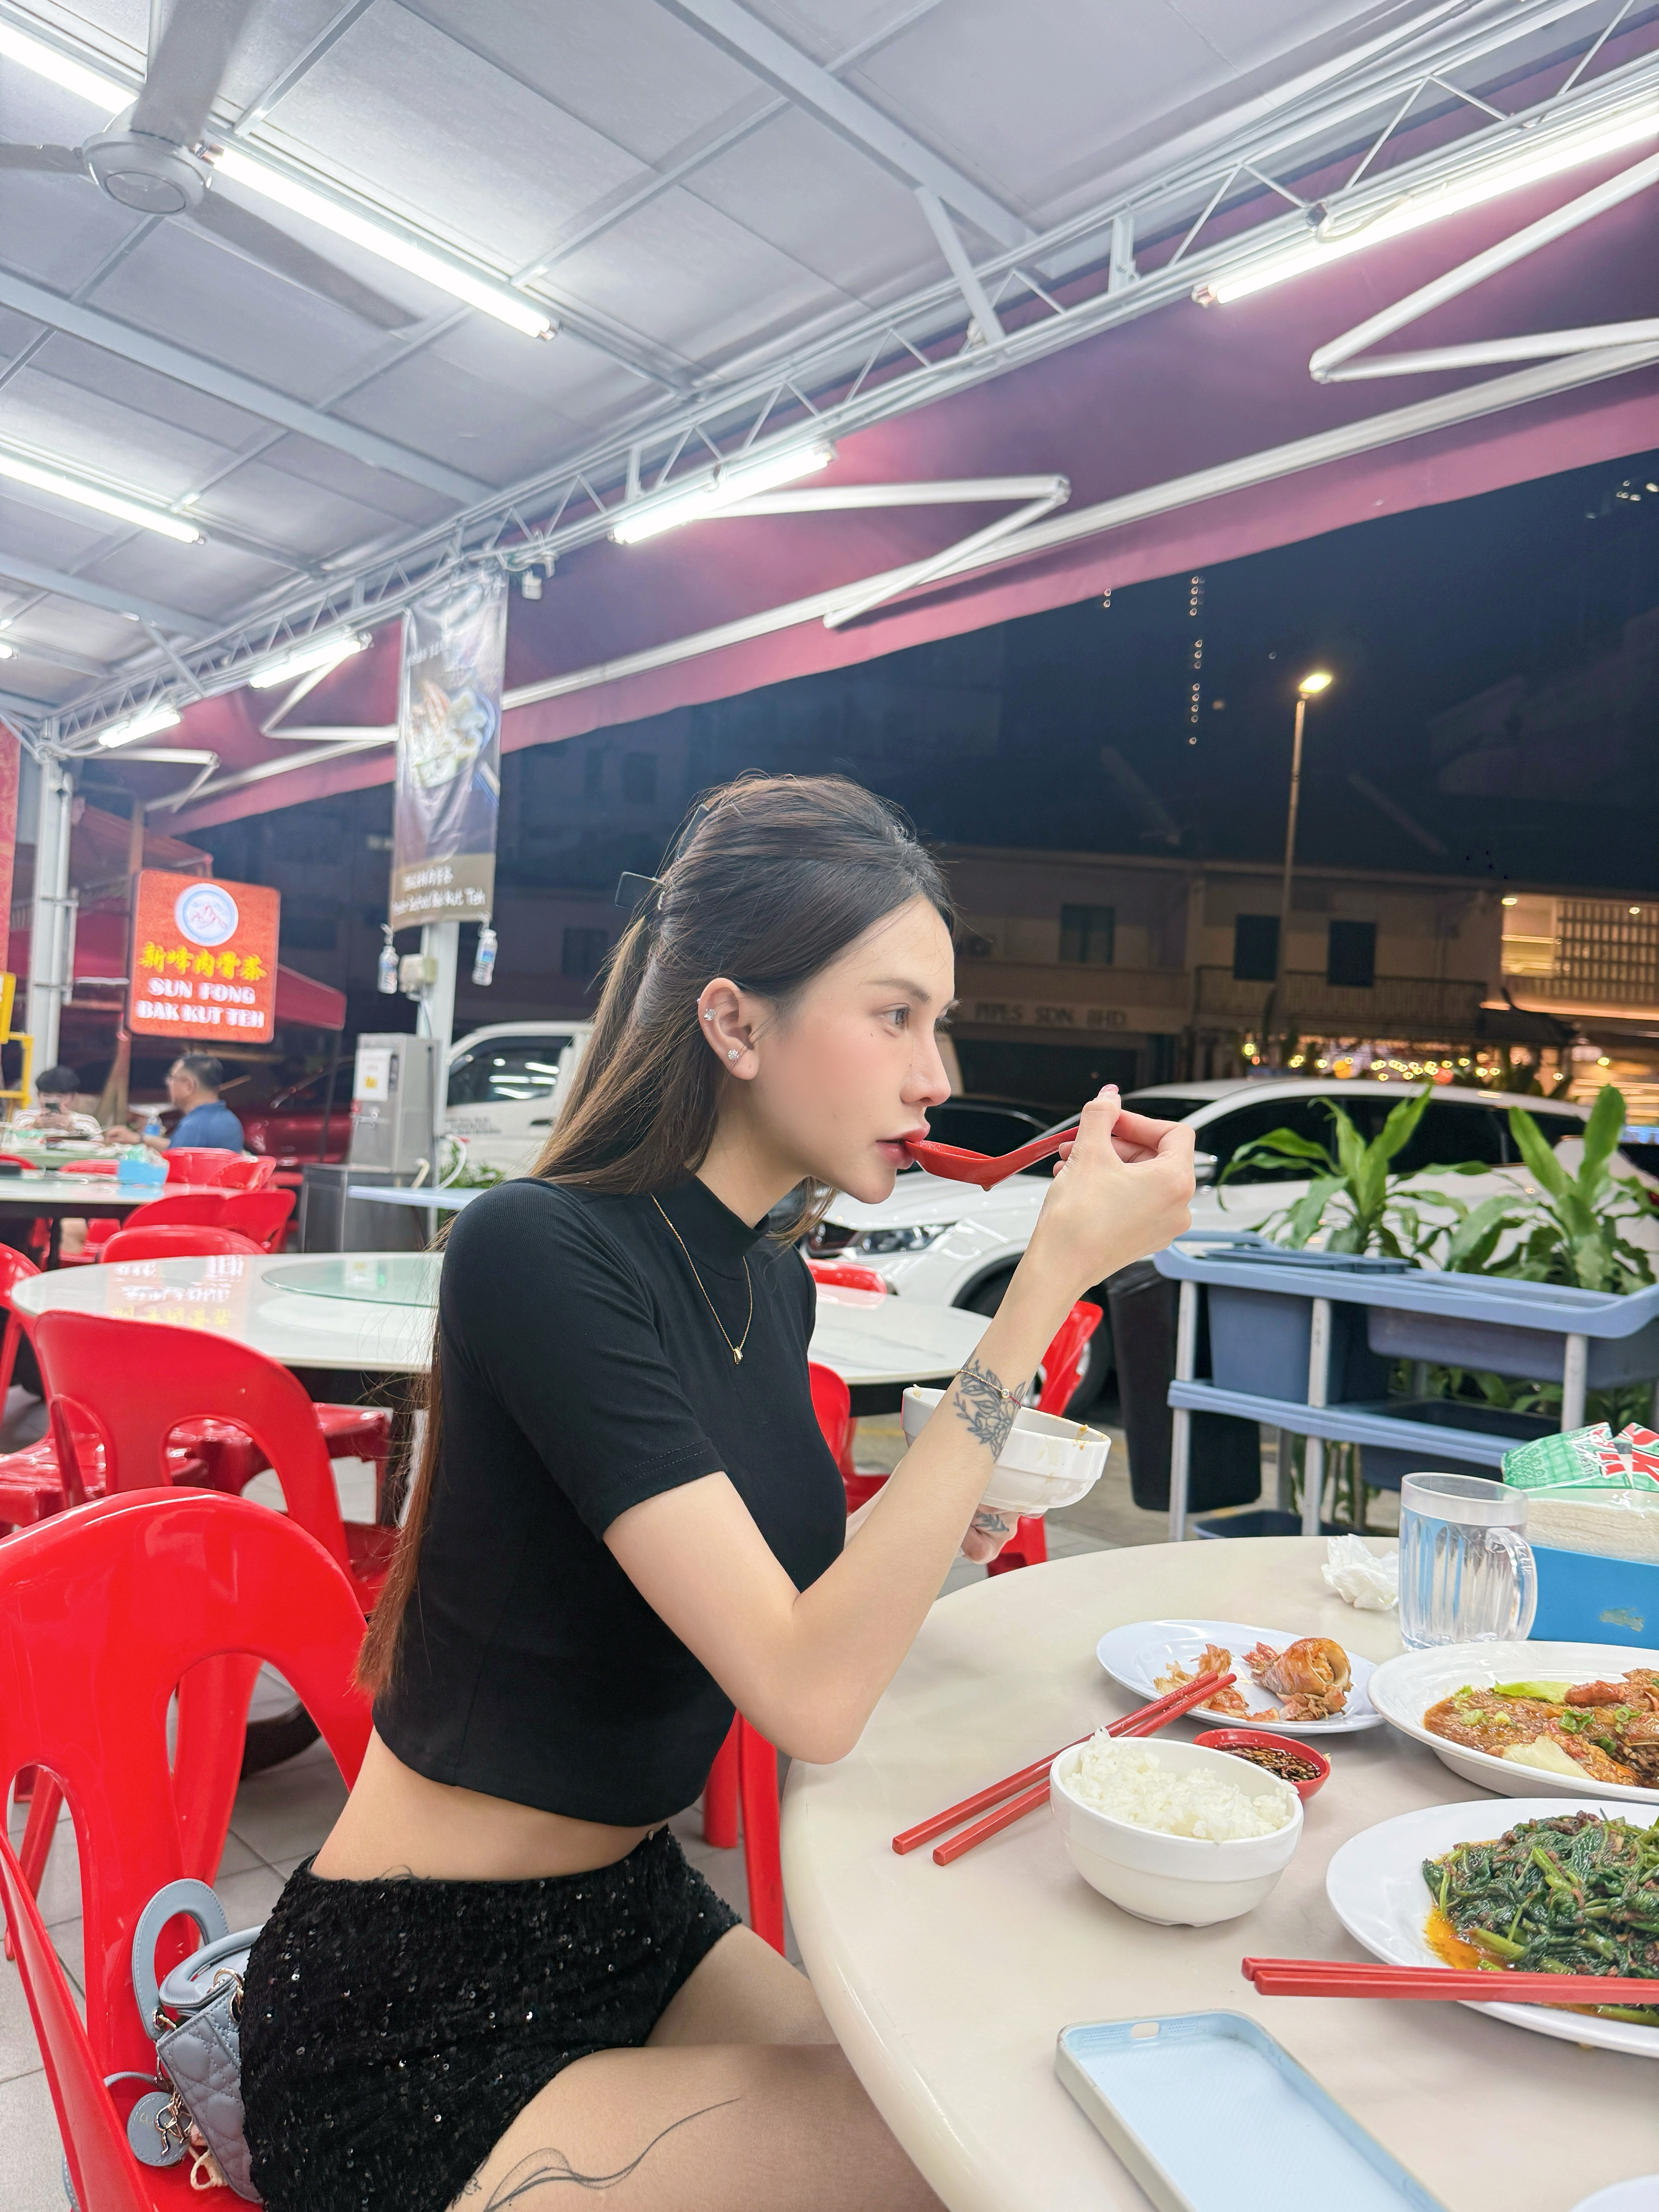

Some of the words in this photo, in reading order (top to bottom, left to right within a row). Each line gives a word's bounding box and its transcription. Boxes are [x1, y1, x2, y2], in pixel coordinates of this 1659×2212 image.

[147, 977, 193, 998] SUN
[198, 982, 256, 1005] FONG
[135, 1000, 180, 1021] BAK
[180, 1004, 223, 1024] KUT
[225, 1008, 264, 1028] TEH
[1035, 1006, 1075, 1026] SDN
[1087, 1008, 1127, 1029] BHD
